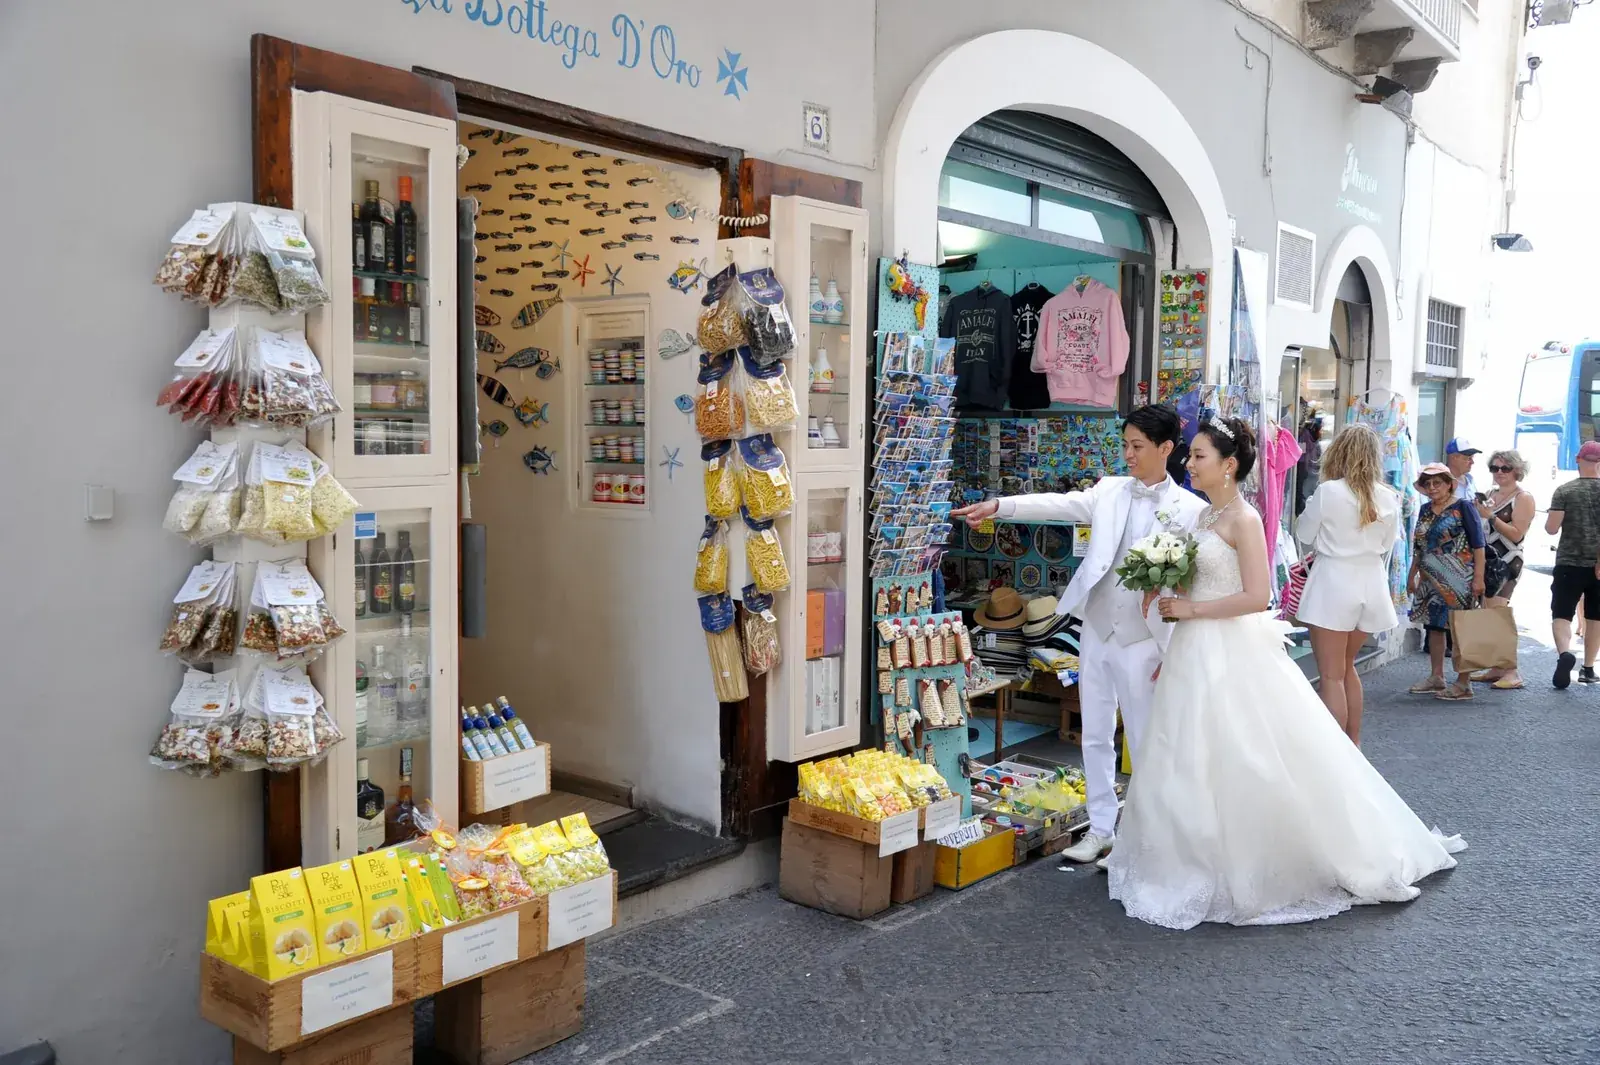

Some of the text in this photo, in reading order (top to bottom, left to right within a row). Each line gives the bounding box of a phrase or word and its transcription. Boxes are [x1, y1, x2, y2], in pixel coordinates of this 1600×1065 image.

[612, 14, 701, 88] D'Oro
[809, 115, 823, 141] 6
[960, 314, 996, 330] AMALFI
[1062, 311, 1098, 324] AMALFI
[364, 877, 400, 892] BISCOTTI
[317, 889, 356, 905] BISCOTTI
[265, 899, 306, 914] BISCOTTI
